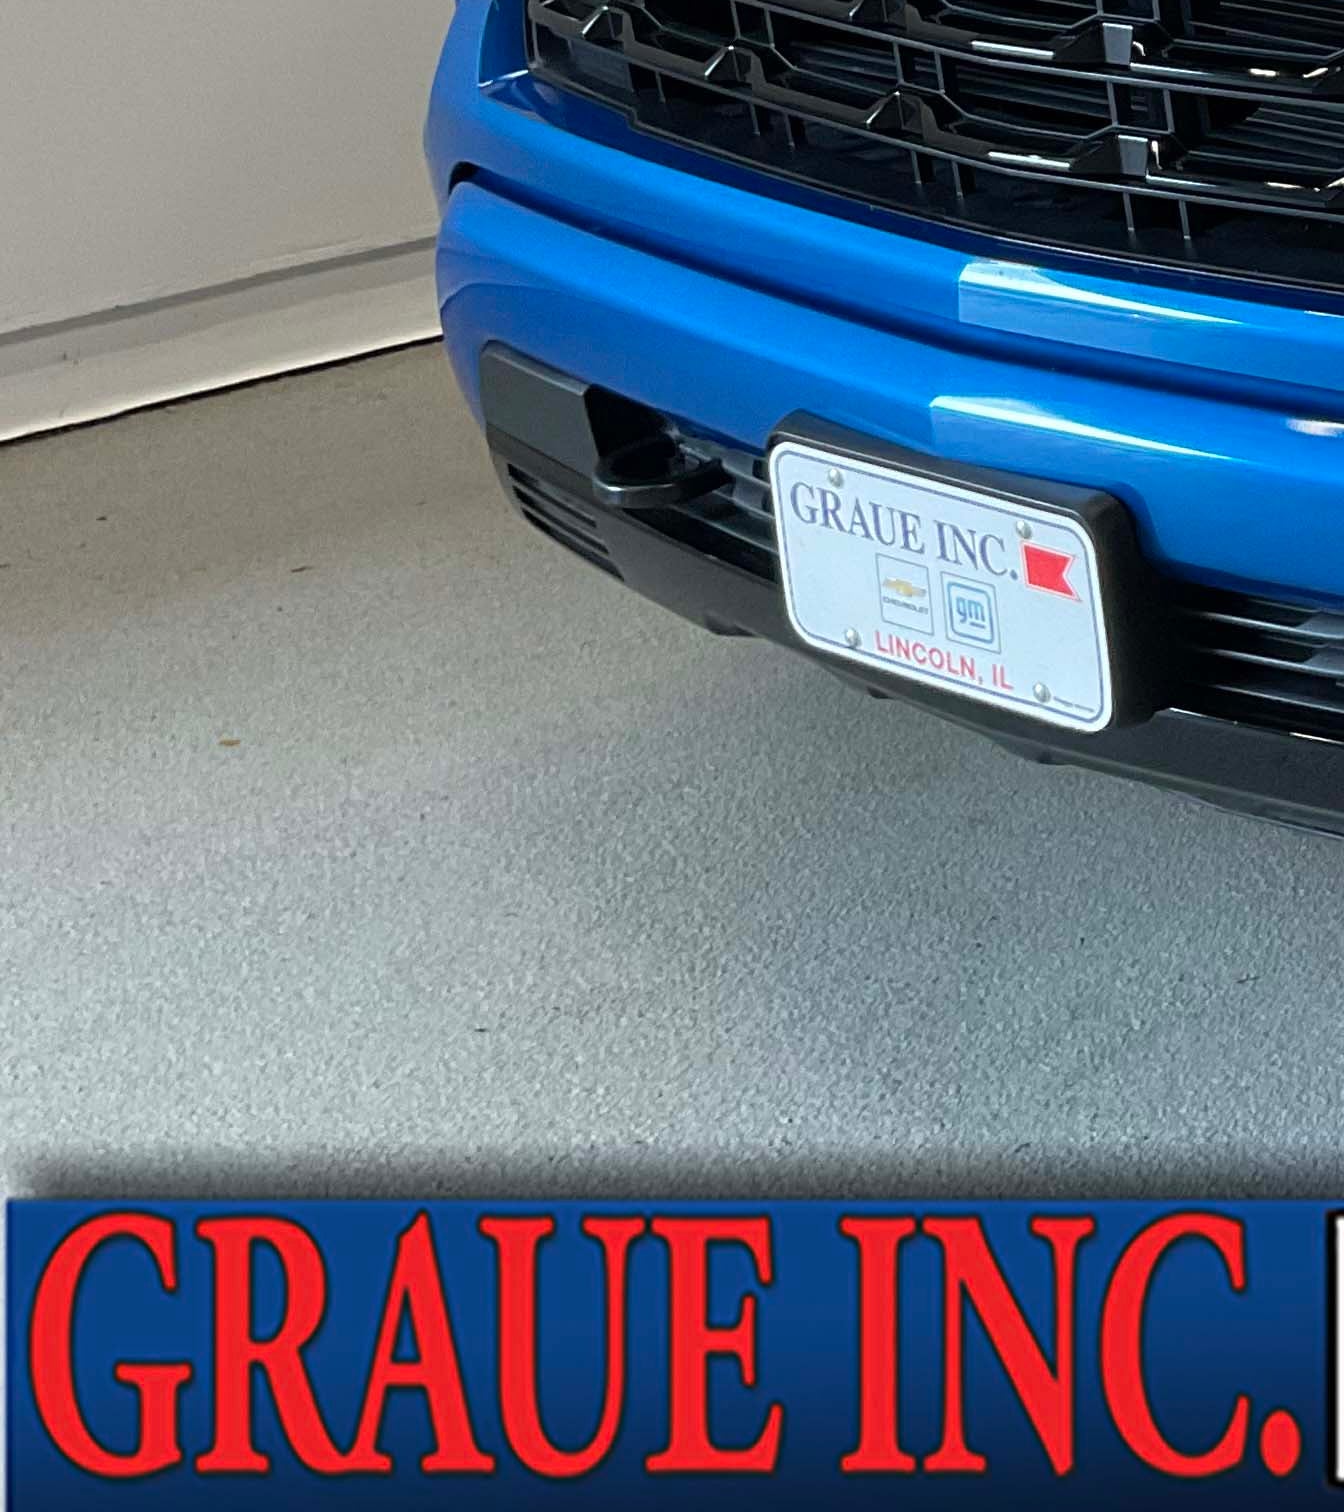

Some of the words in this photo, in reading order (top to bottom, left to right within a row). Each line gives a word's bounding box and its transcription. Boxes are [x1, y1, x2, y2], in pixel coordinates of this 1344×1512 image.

[790, 481, 925, 556] GRAUE
[933, 519, 1019, 581] INC.
[957, 599, 986, 628] gm
[875, 631, 984, 686] LINCOLN,
[991, 664, 1014, 691] IL
